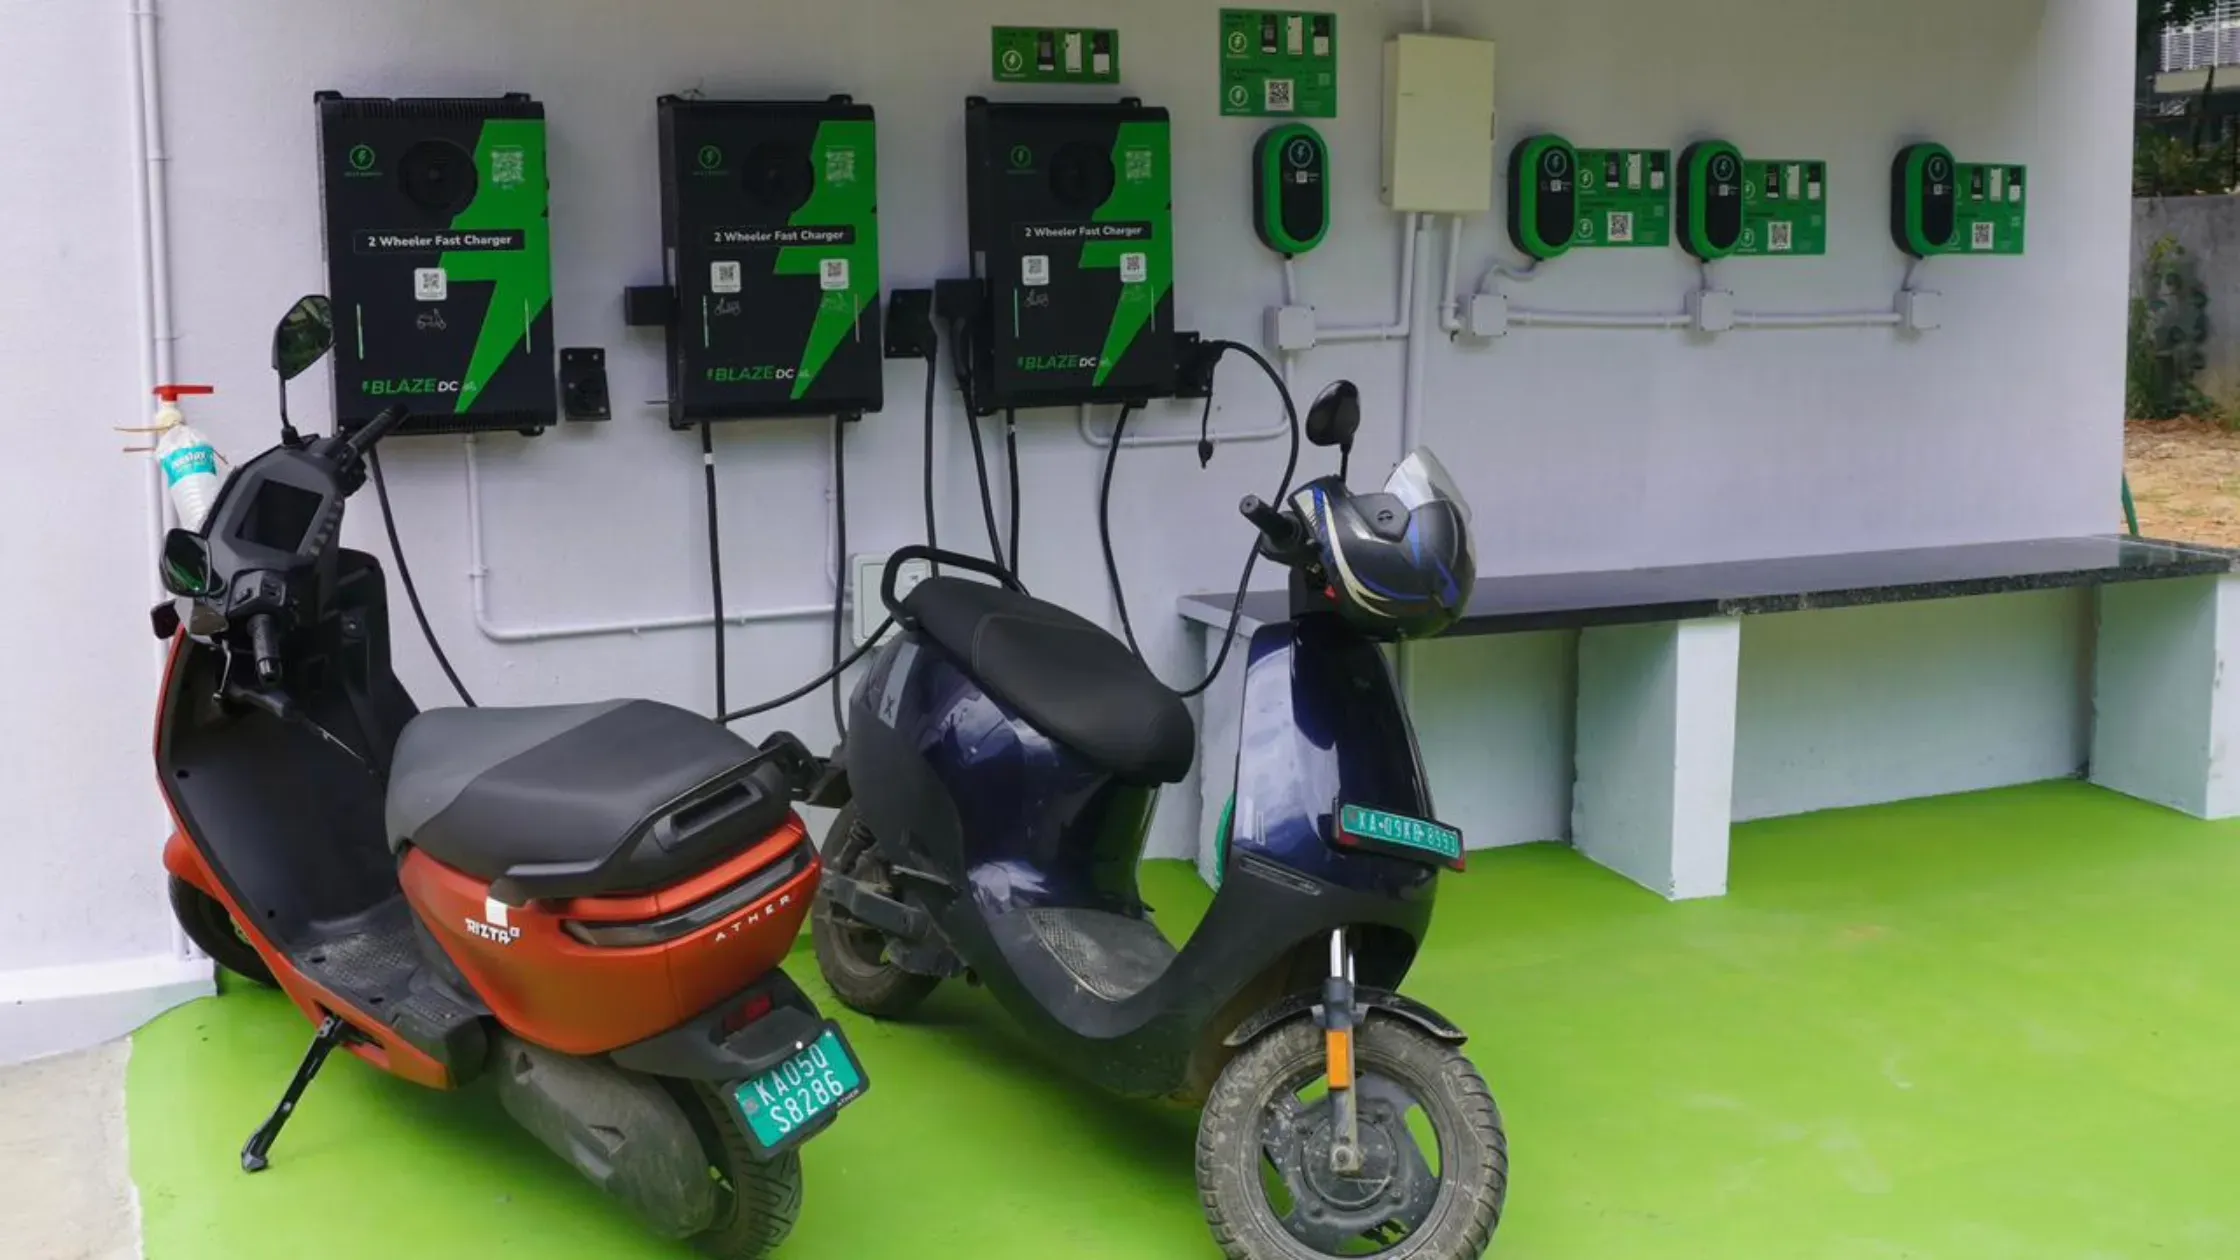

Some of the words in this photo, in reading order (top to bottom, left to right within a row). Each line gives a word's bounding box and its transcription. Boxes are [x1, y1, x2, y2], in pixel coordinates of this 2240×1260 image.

[714, 231, 722, 242] 2
[724, 230, 771, 242] Wheeler
[774, 230, 798, 241] Fast
[800, 229, 844, 243] Charger
[1025, 227, 1031, 237] 2
[1033, 226, 1076, 237] Wheeler
[1079, 226, 1101, 236] Fast
[1103, 225, 1142, 238] Charger
[368, 237, 376, 247] 2
[379, 235, 432, 247] Wheeler
[435, 235, 461, 246] Fast
[463, 234, 512, 247] Charger
[1025, 355, 1079, 370] BLAZE
[1079, 356, 1096, 367] DC
[715, 365, 775, 381] BLAZE
[775, 368, 794, 379] DC
[371, 378, 437, 395] BLAZE
[437, 381, 460, 393] DC
[715, 894, 791, 942] ATHER
[464, 917, 511, 945] RIZTA
[769, 1070, 844, 1133] S8286
